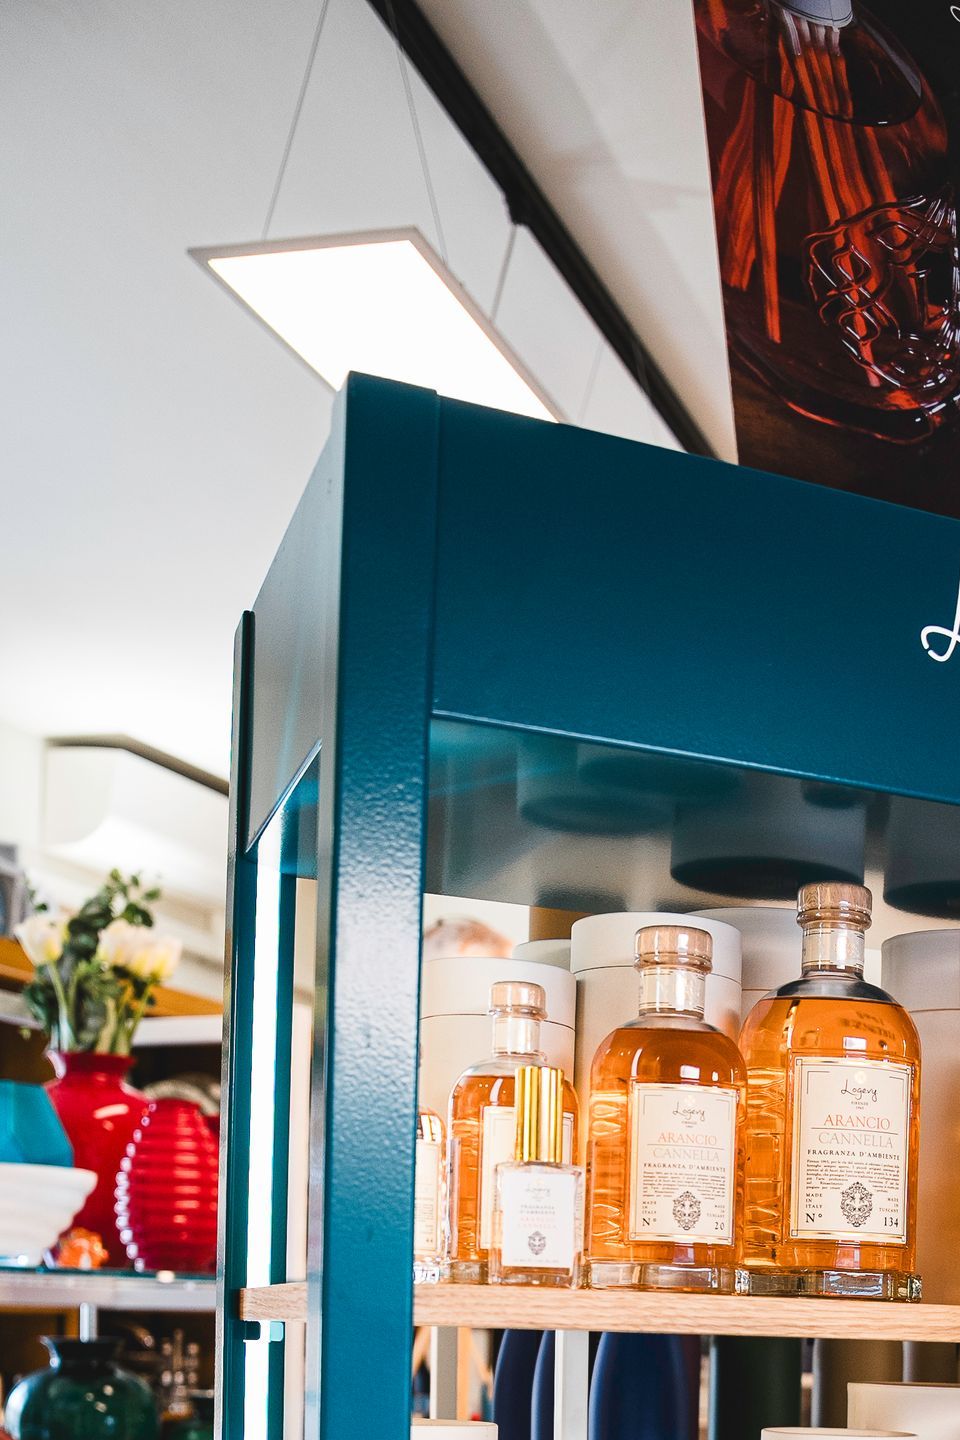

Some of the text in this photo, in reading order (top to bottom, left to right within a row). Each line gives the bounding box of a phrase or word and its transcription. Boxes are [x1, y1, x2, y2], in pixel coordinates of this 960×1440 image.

[841, 1079, 879, 1102] Logevy
[823, 1114, 890, 1130] ARANCIO
[658, 1132, 717, 1145] ARANCIO
[818, 1132, 893, 1149] CANNELLA
[652, 1149, 720, 1162] CANNELLA
[807, 1149, 900, 1161] FRAGRANZA D'AMBIENTE
[689, 1164, 726, 1173] D'AMBIENTE
[714, 1221, 725, 1230] 20
[883, 1217, 899, 1228] 134
